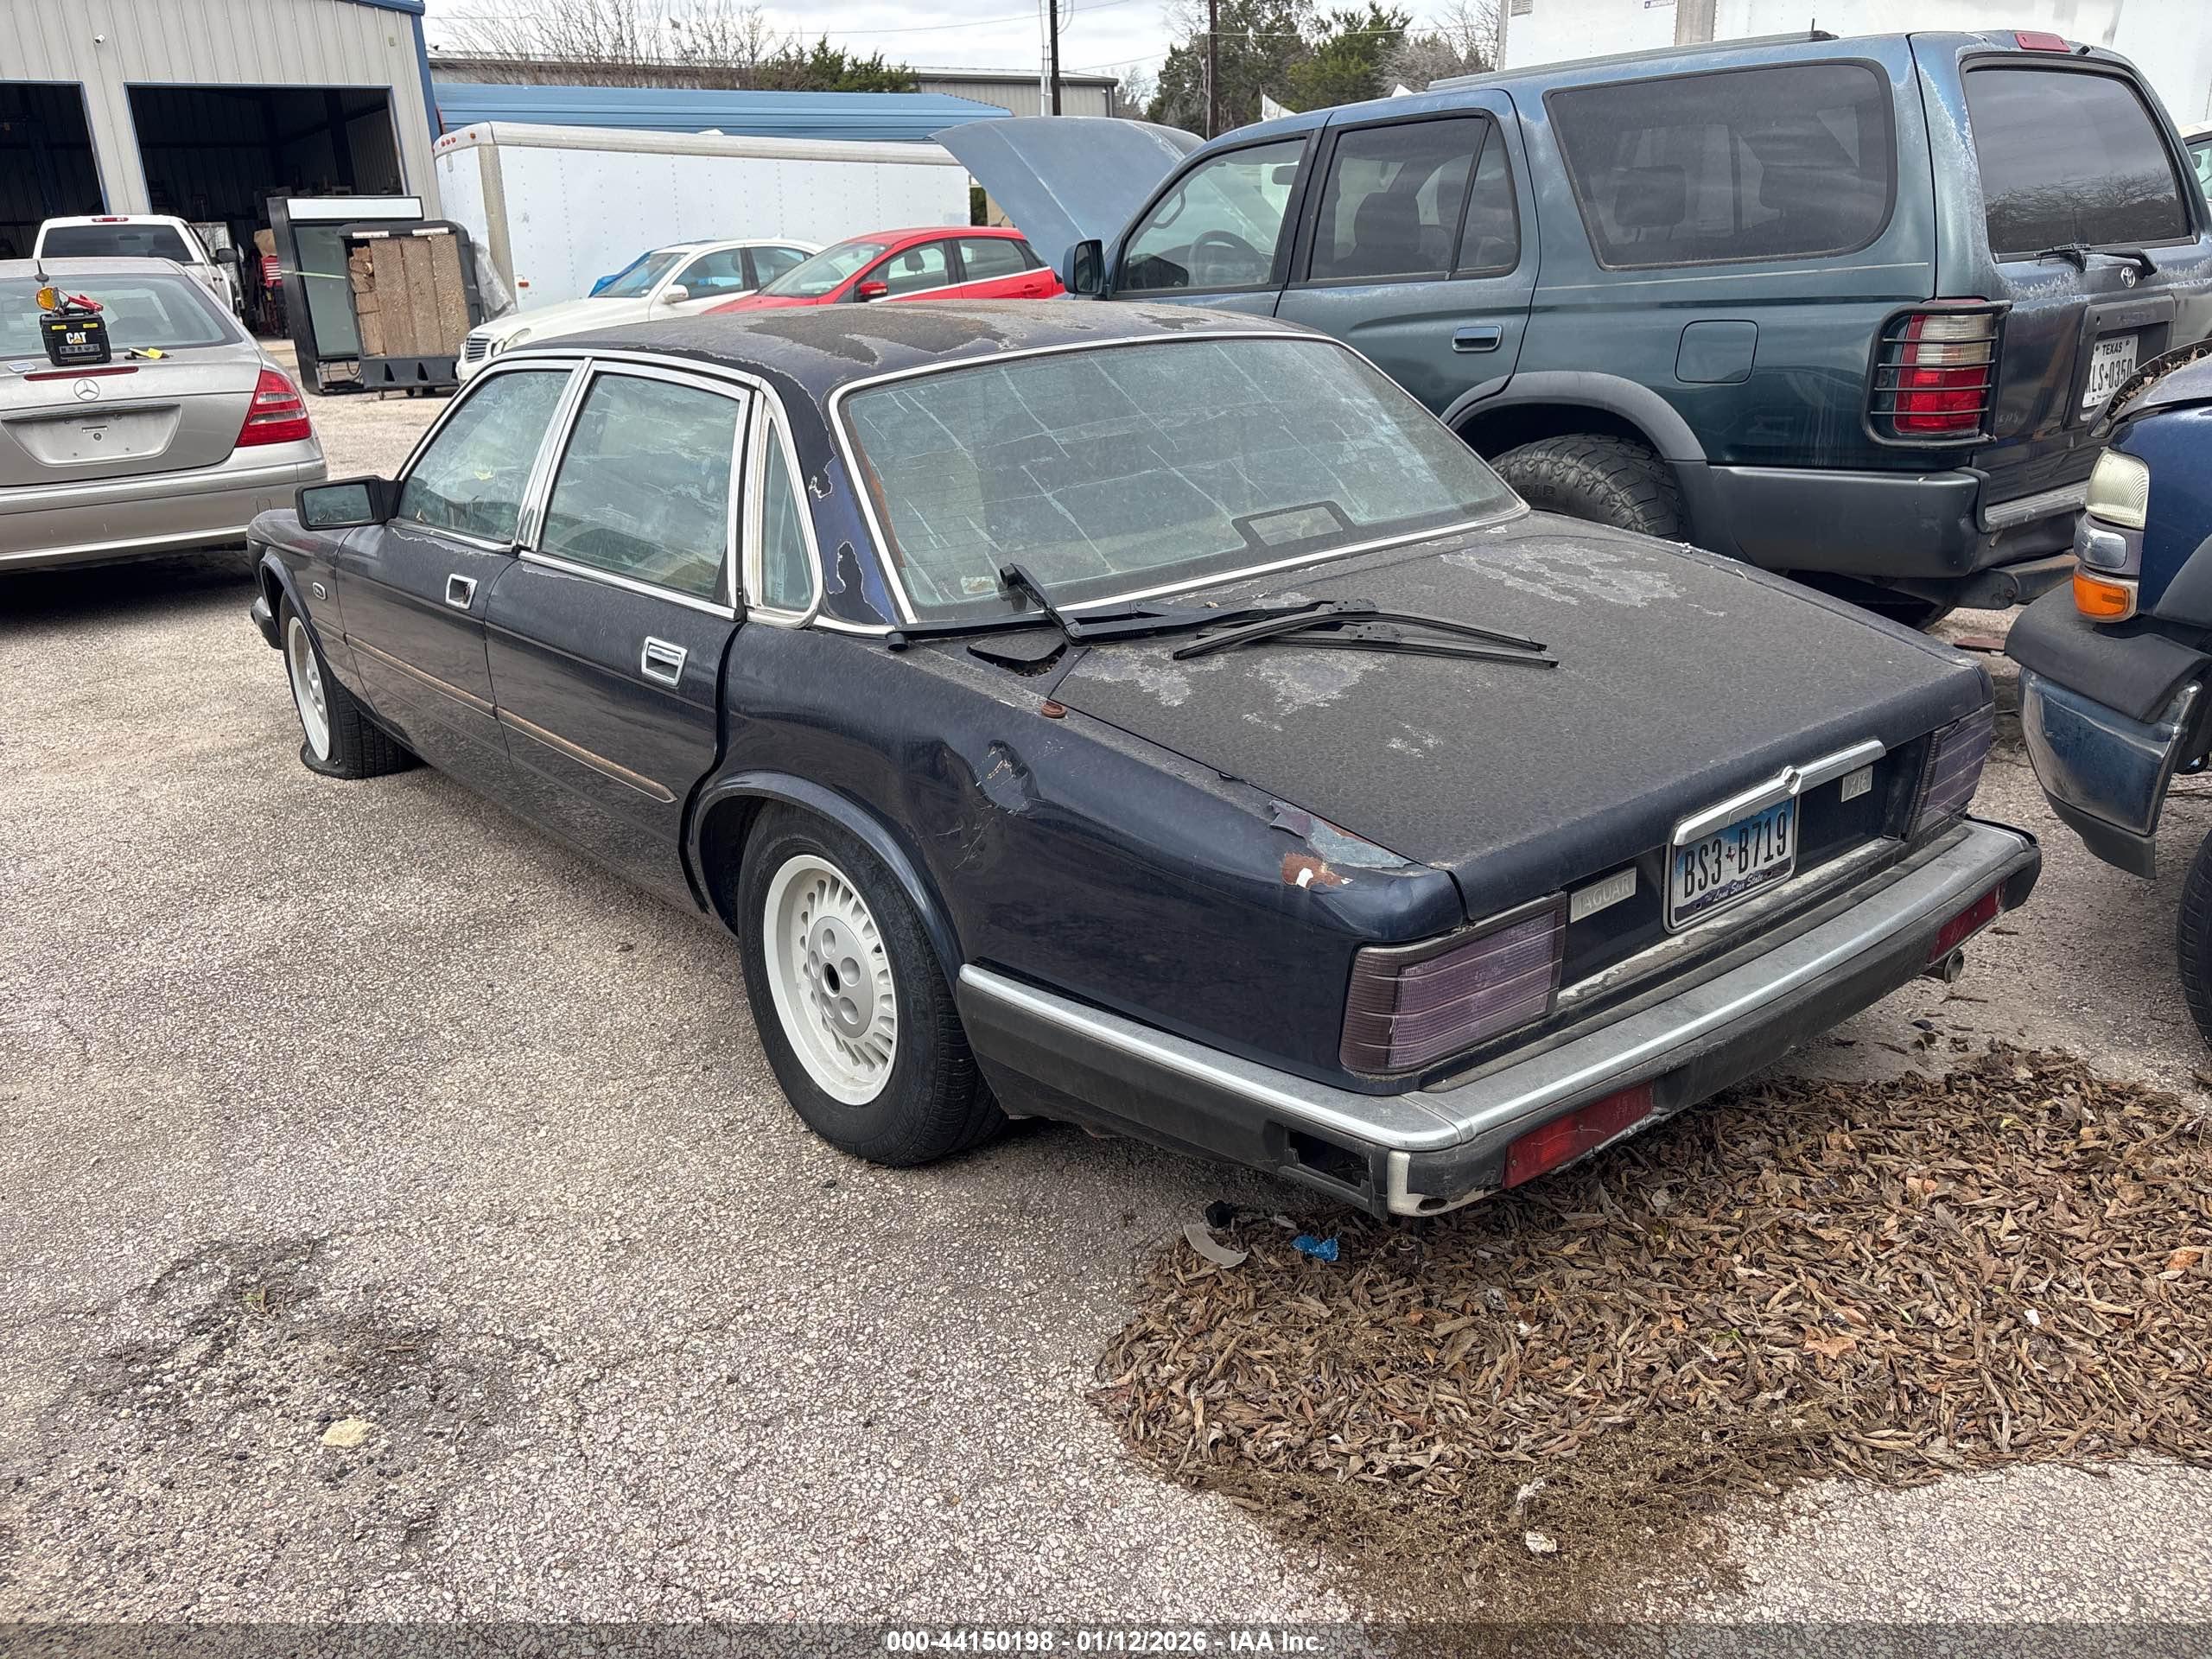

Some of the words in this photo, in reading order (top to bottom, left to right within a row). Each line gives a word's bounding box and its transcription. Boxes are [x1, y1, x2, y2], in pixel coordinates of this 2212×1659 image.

[66, 332, 86, 344] CAT
[2102, 341, 2123, 356] TEXAS
[1574, 876, 1630, 916] JAGUAR
[1713, 888, 1729, 902] Lone
[1730, 881, 1745, 895] Star
[1746, 873, 1764, 887] State
